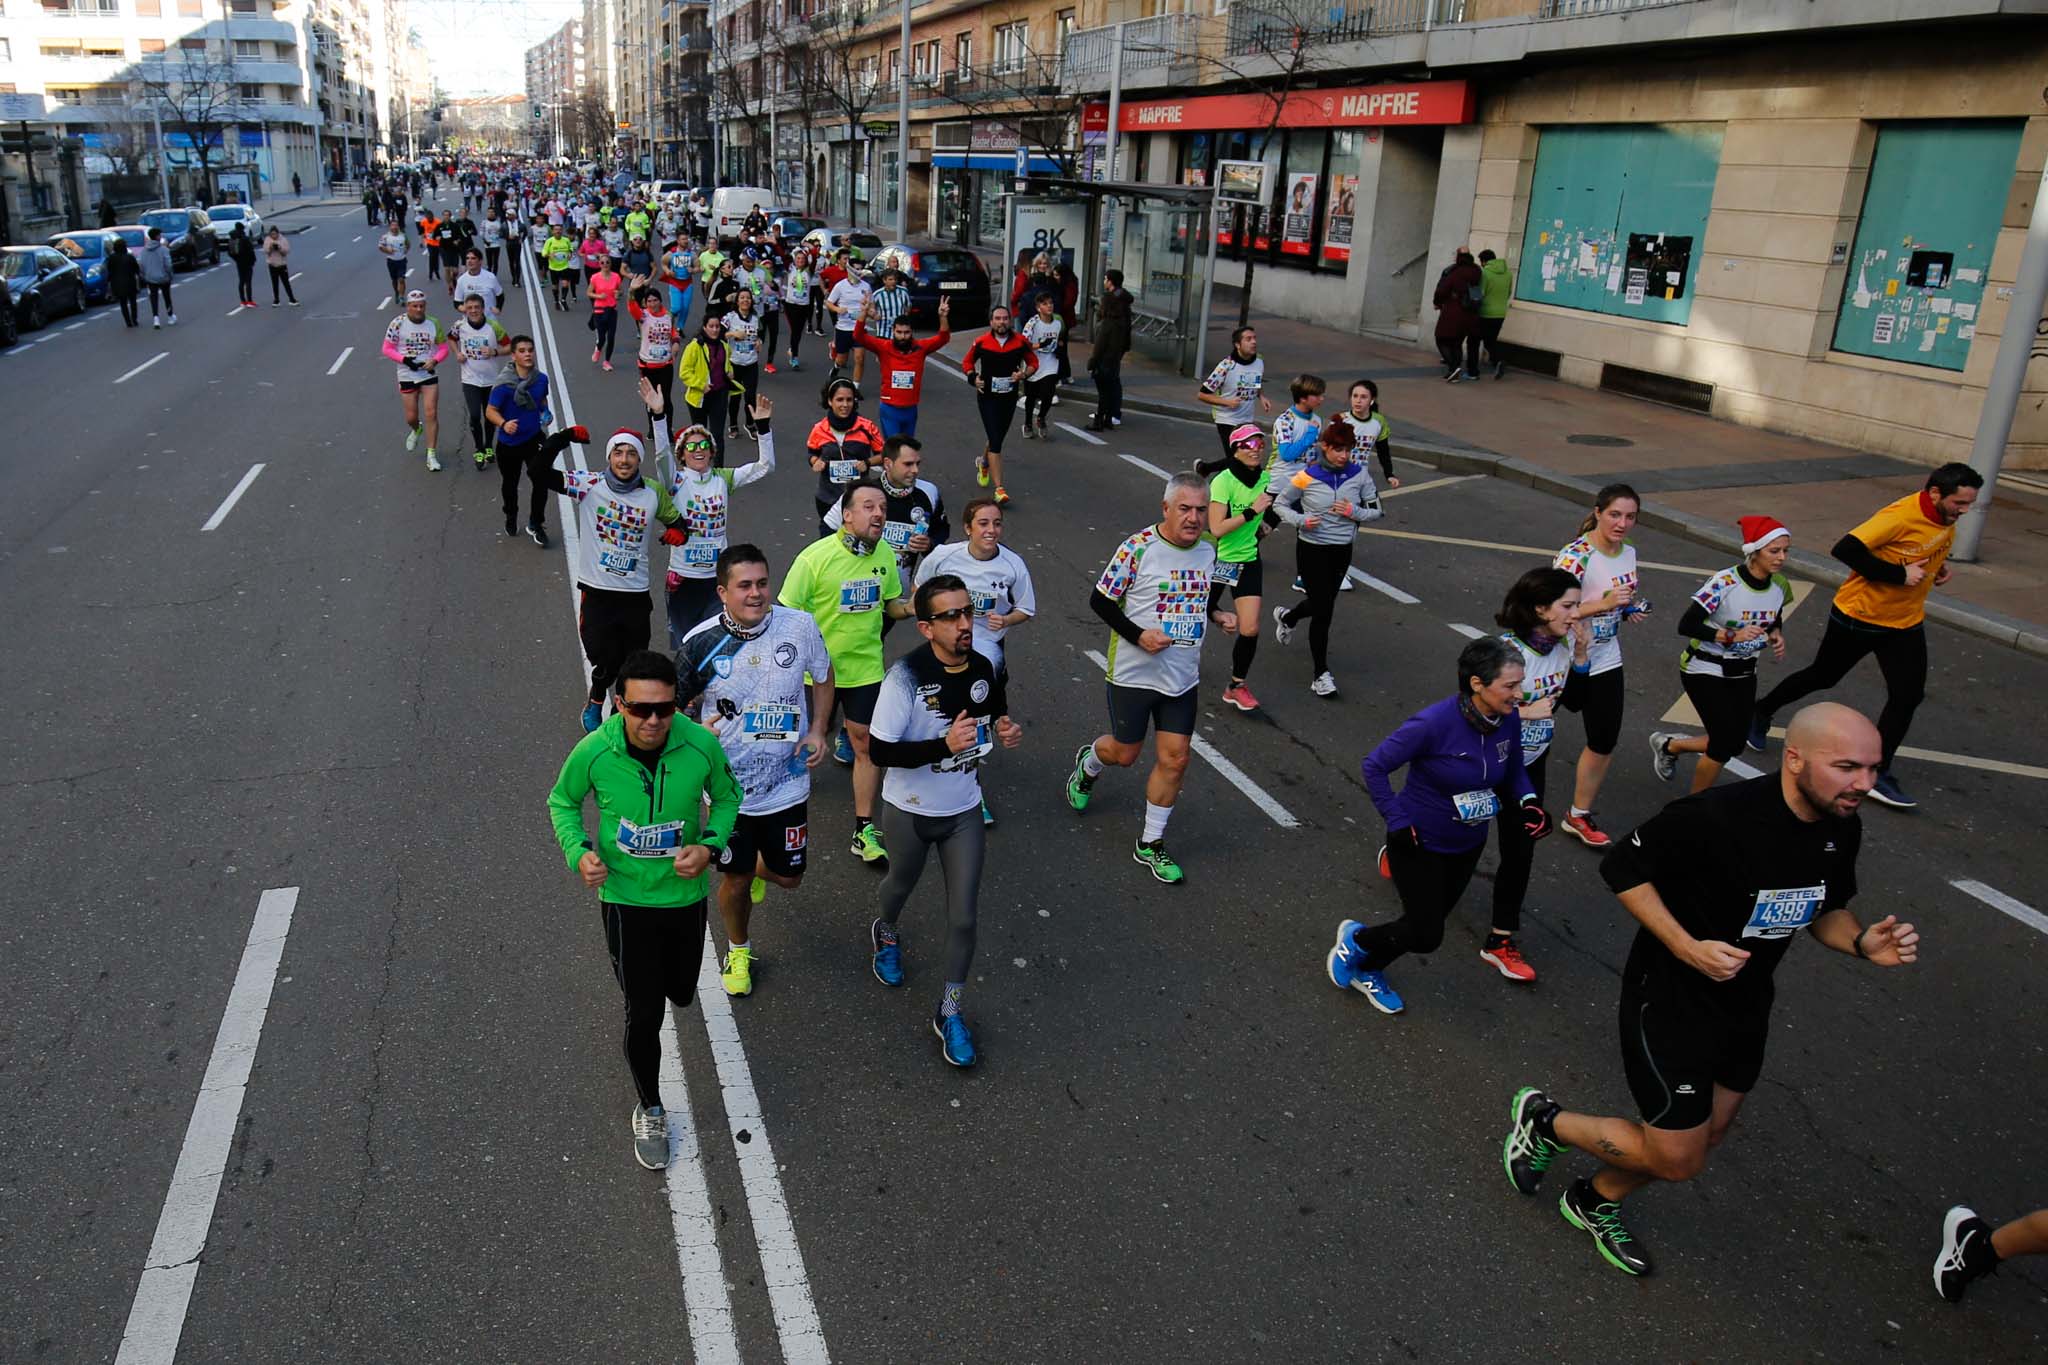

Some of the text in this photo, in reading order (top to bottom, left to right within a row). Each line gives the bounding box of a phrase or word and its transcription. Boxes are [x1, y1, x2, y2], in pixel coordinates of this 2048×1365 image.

[1341, 92, 1420, 117] MAPFRE
[1138, 105, 1183, 124] MAPFRE
[1033, 228, 1066, 249] 8K
[604, 553, 630, 570] 4500
[689, 548, 713, 561] 4499
[850, 587, 869, 602] 4181
[1169, 622, 1196, 637] 4182
[759, 704, 796, 712] SETEL
[752, 713, 785, 729] 4102
[1467, 800, 1494, 819] 2236
[635, 823, 676, 834] SETEL
[629, 833, 662, 848] 4101
[1775, 890, 1819, 900] SETEL
[1760, 901, 1808, 923] 4398
